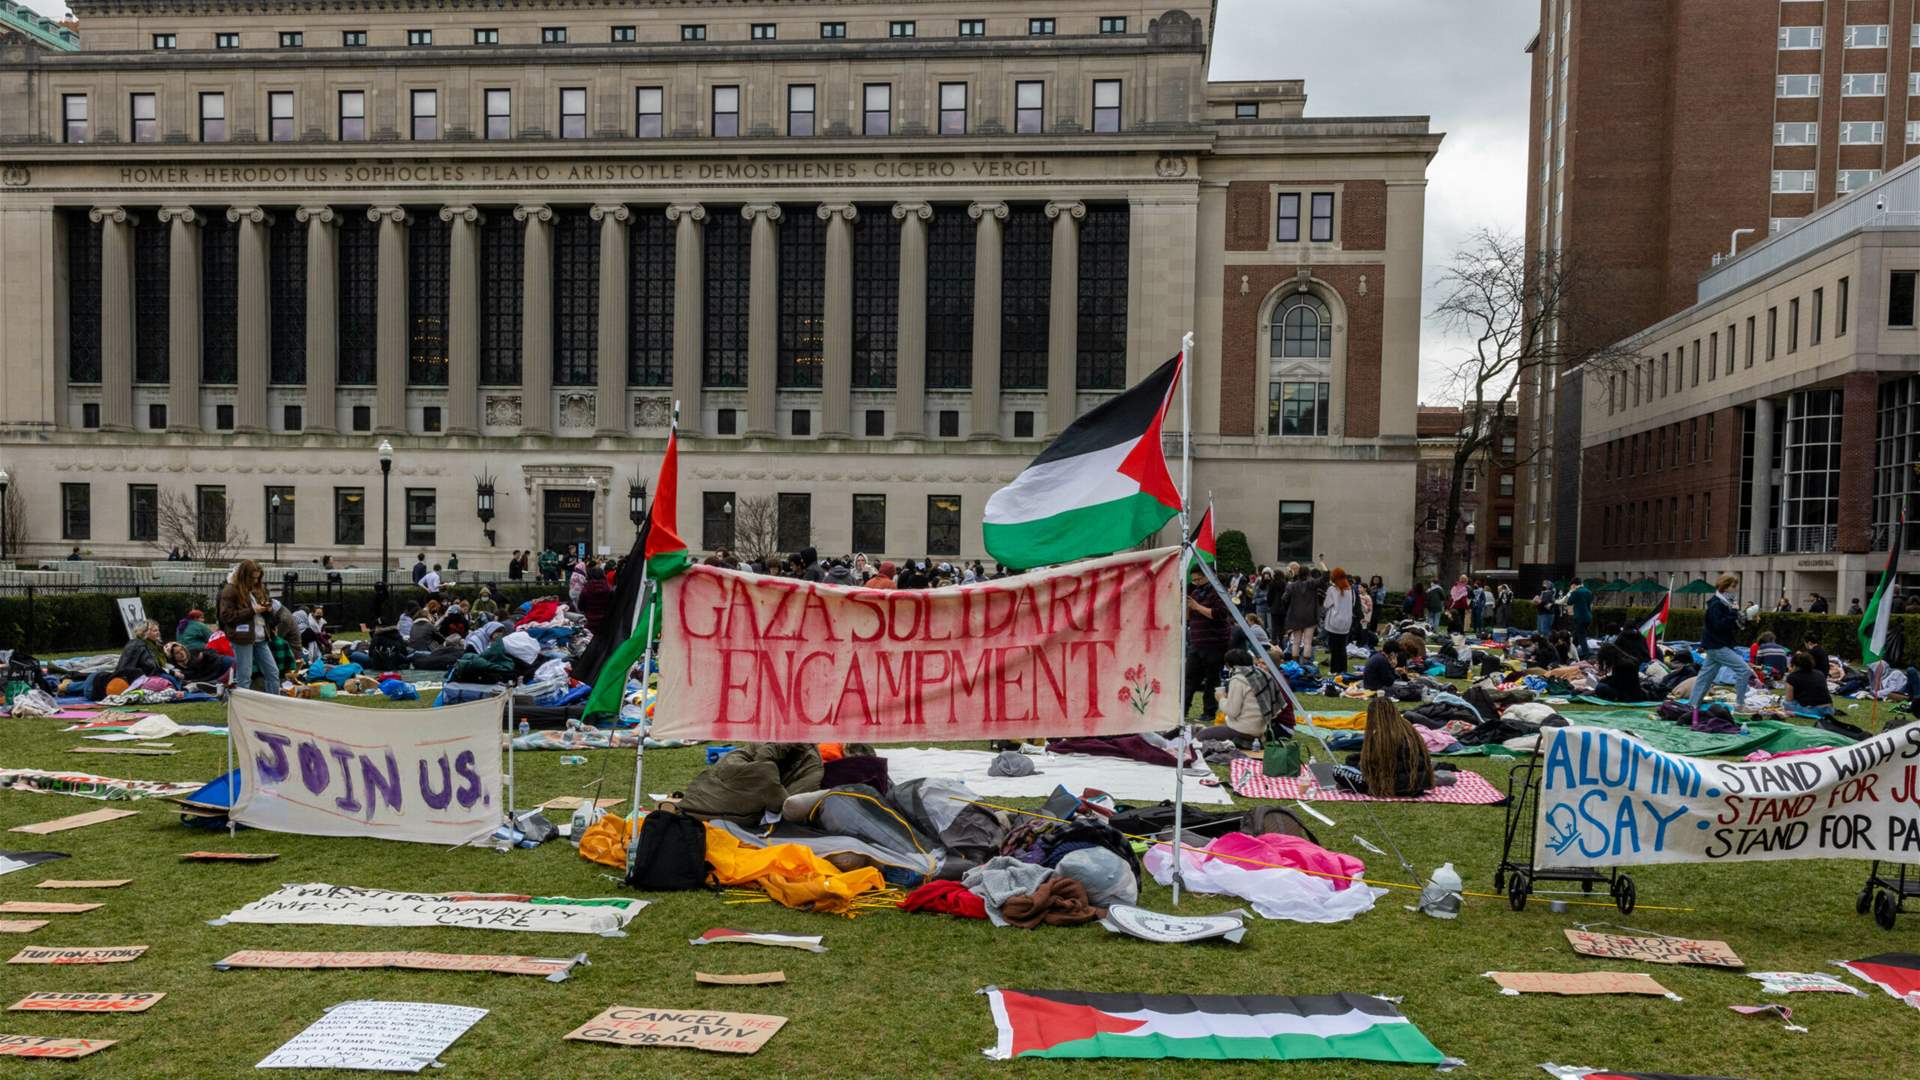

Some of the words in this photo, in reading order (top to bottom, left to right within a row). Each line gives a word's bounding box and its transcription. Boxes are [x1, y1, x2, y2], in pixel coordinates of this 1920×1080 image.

[120, 168, 188, 183] HOMER
[204, 167, 328, 183] HERODOTUS
[345, 167, 464, 182] SOPHOCLES
[482, 165, 550, 181] PLATO
[569, 164, 683, 180] ARISTOTLE
[700, 163, 856, 179] DEMOSTHENES
[874, 162, 955, 178] CICERO
[972, 160, 1053, 177] VERGIL
[680, 570, 840, 642] GAZA
[713, 640, 1115, 725] ENCAMPMENT
[1717, 761, 1822, 795] STAND
[1828, 736, 1896, 781] WITH
[1900, 728, 1920, 759] S
[254, 730, 404, 820] JOIN
[419, 750, 491, 811] US.
[1717, 794, 1817, 827] STAND
[1828, 773, 1879, 810] FOR
[1891, 765, 1920, 805] JU
[1704, 821, 1808, 858] STAND
[1820, 814, 1877, 851] FOR
[1888, 816, 1920, 852] PA
[413, 903, 579, 918] COMMUNITY
[22, 950, 89, 958] TUITION
[120, 992, 154, 1000] TO
[609, 1009, 731, 1027] CANCEL
[742, 1018, 777, 1030] THE
[612, 1020, 660, 1032] TEL
[676, 1025, 758, 1038] AVIV
[581, 1027, 695, 1043] GLOBAL
